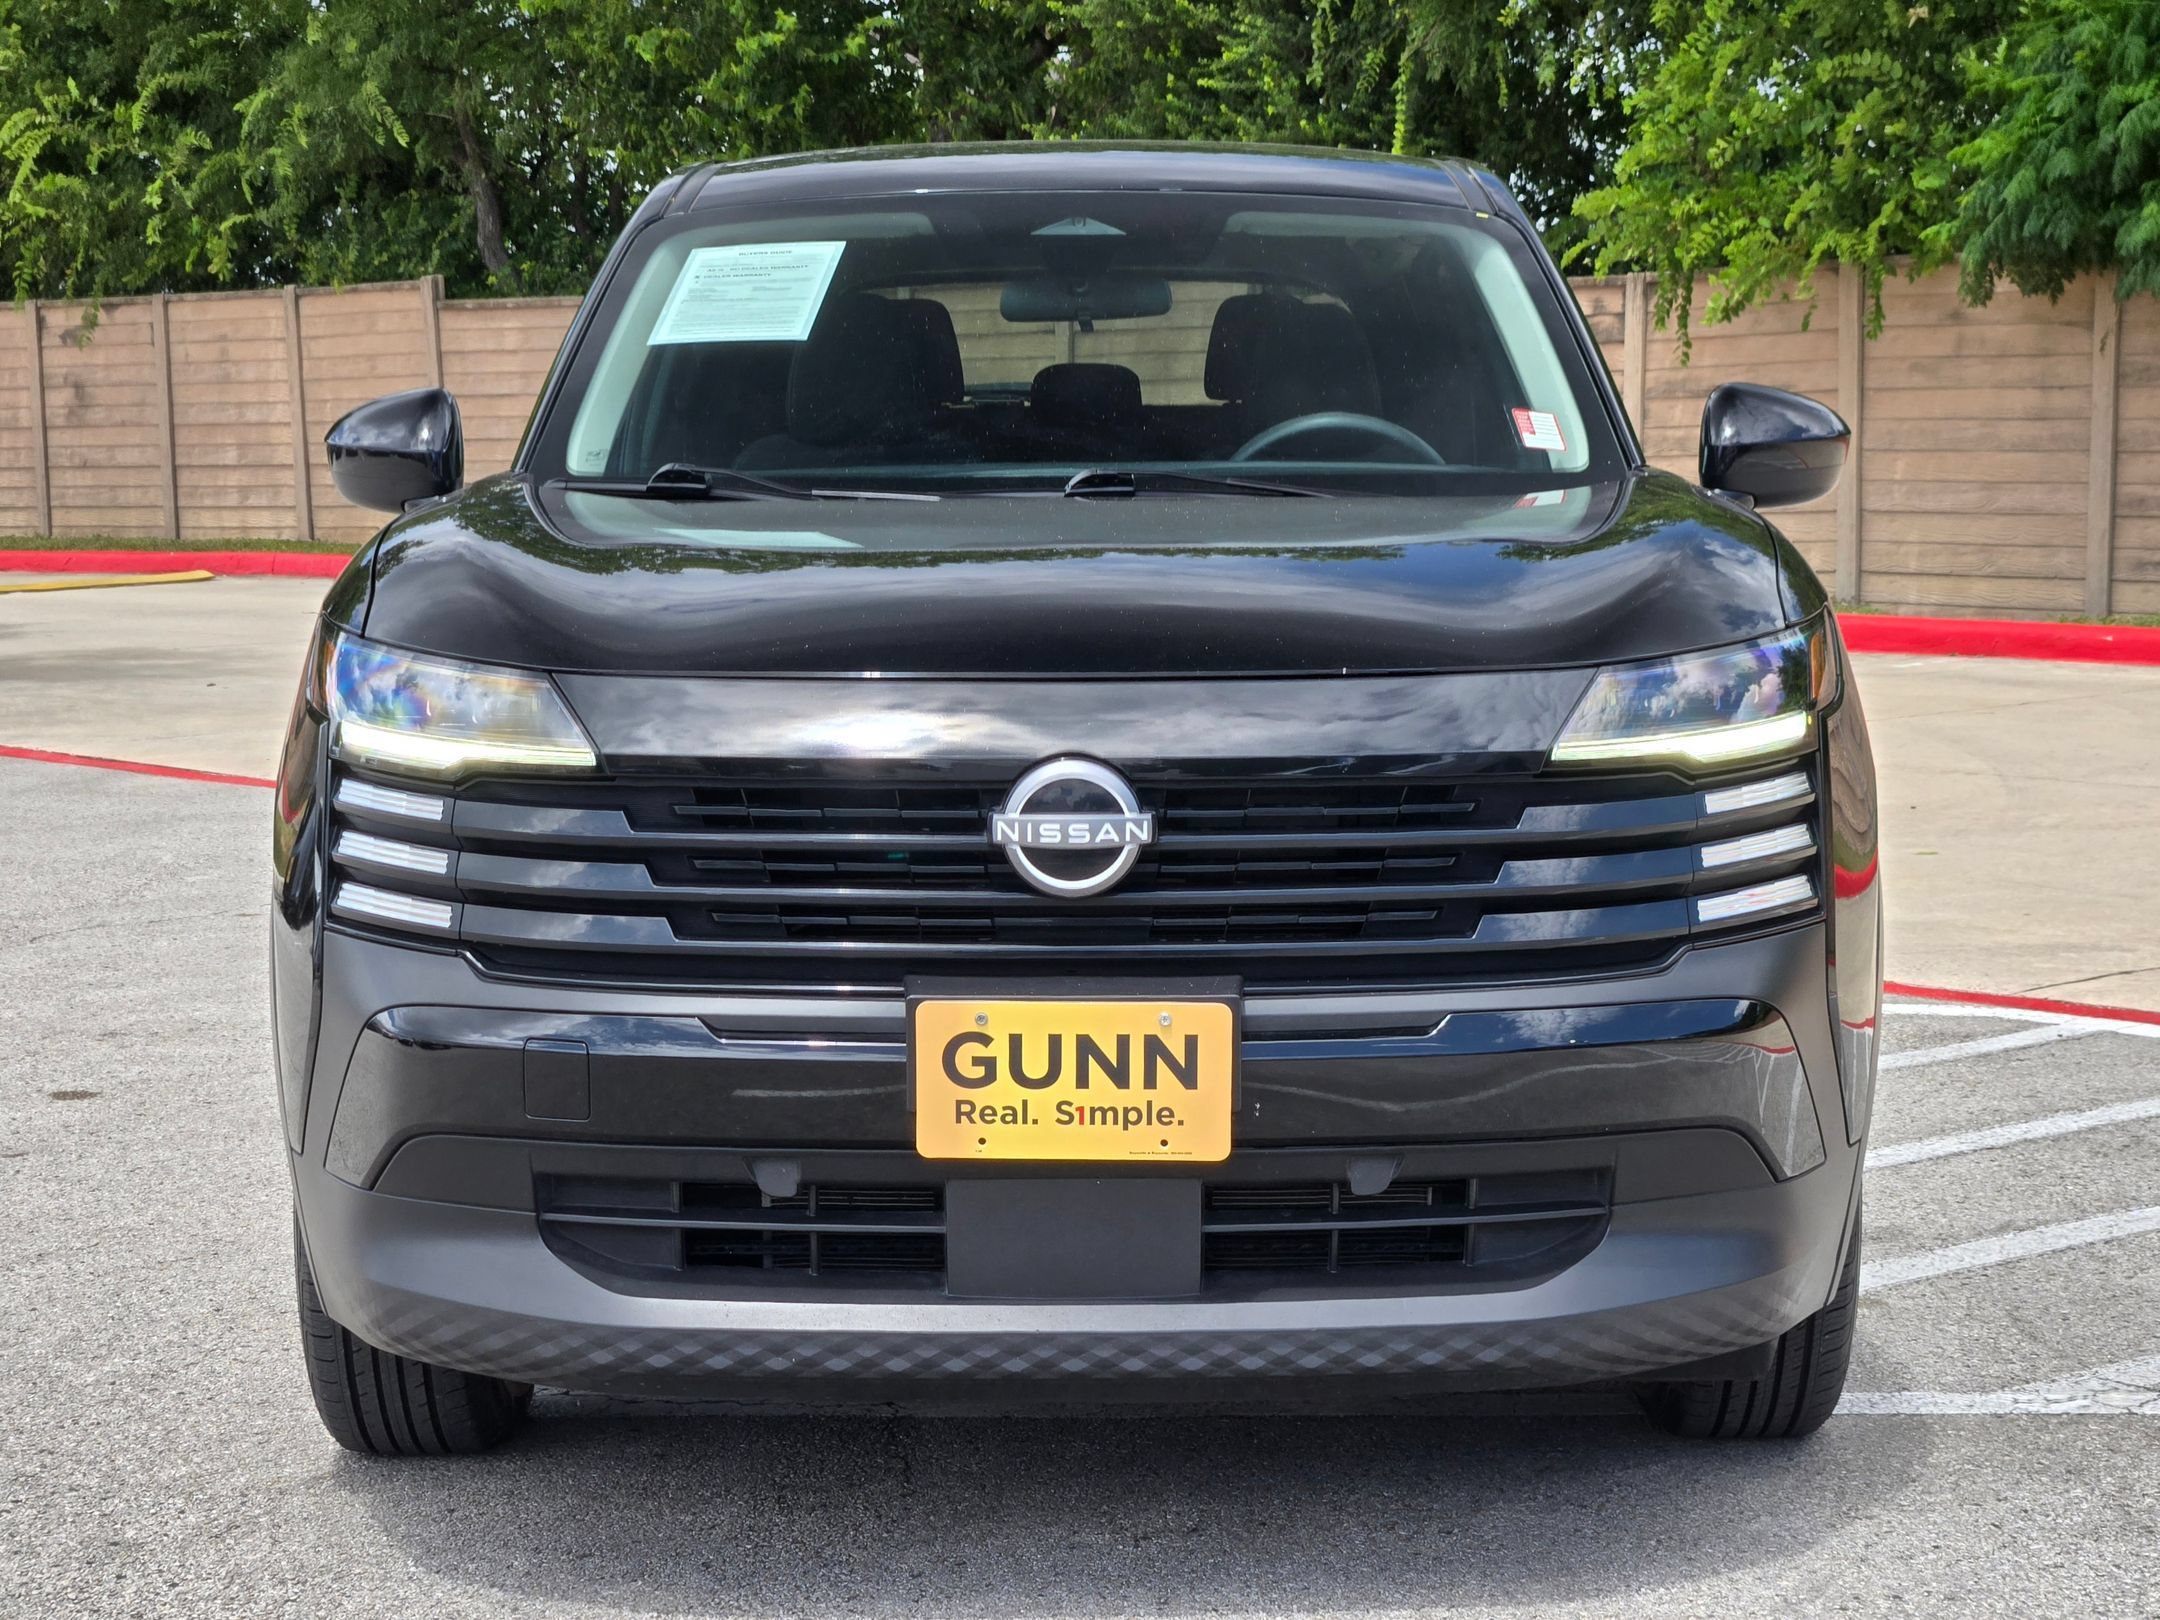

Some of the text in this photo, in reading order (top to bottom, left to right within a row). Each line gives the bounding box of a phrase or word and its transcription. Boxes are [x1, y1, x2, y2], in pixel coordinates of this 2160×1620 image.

[996, 820, 1149, 844] NISSAN
[942, 1031, 1198, 1090] GUNN
[955, 1099, 1039, 1125] Real.
